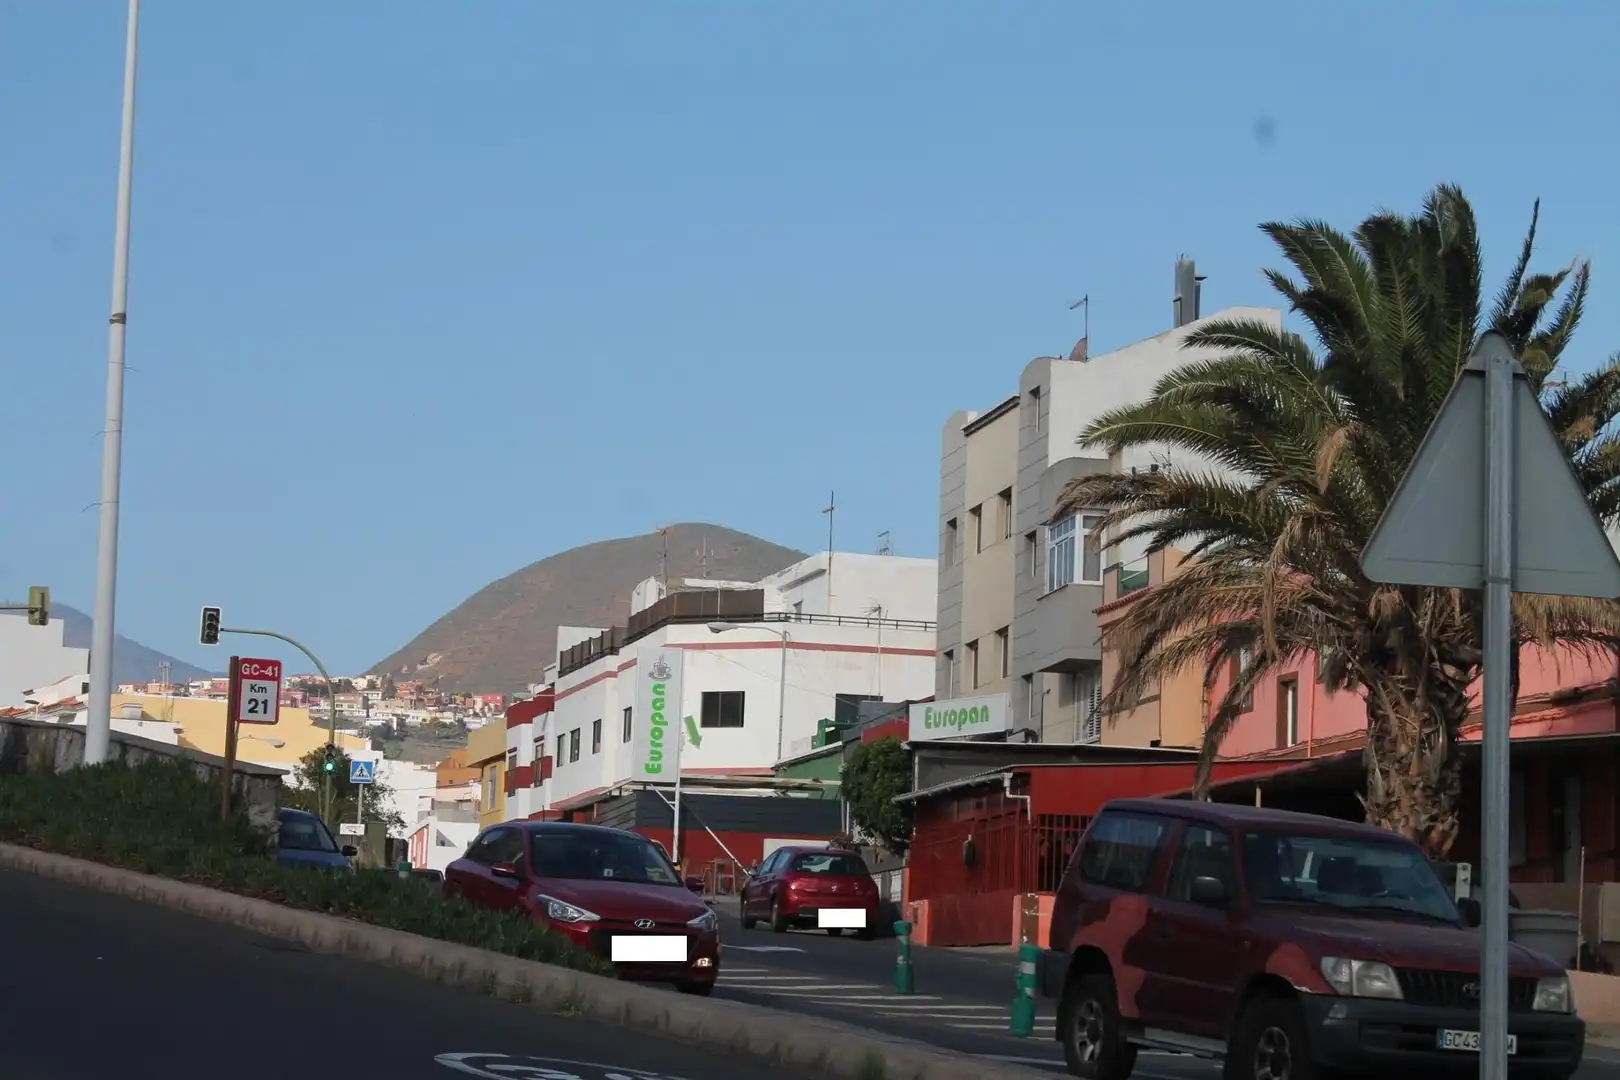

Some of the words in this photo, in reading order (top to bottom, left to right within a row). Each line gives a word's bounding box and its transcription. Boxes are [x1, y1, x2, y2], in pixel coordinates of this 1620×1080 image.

[241, 663, 278, 677] GC-41
[250, 683, 267, 694] Km
[247, 698, 268, 714] 21
[924, 705, 989, 731] Europan
[644, 683, 668, 774] Europan
